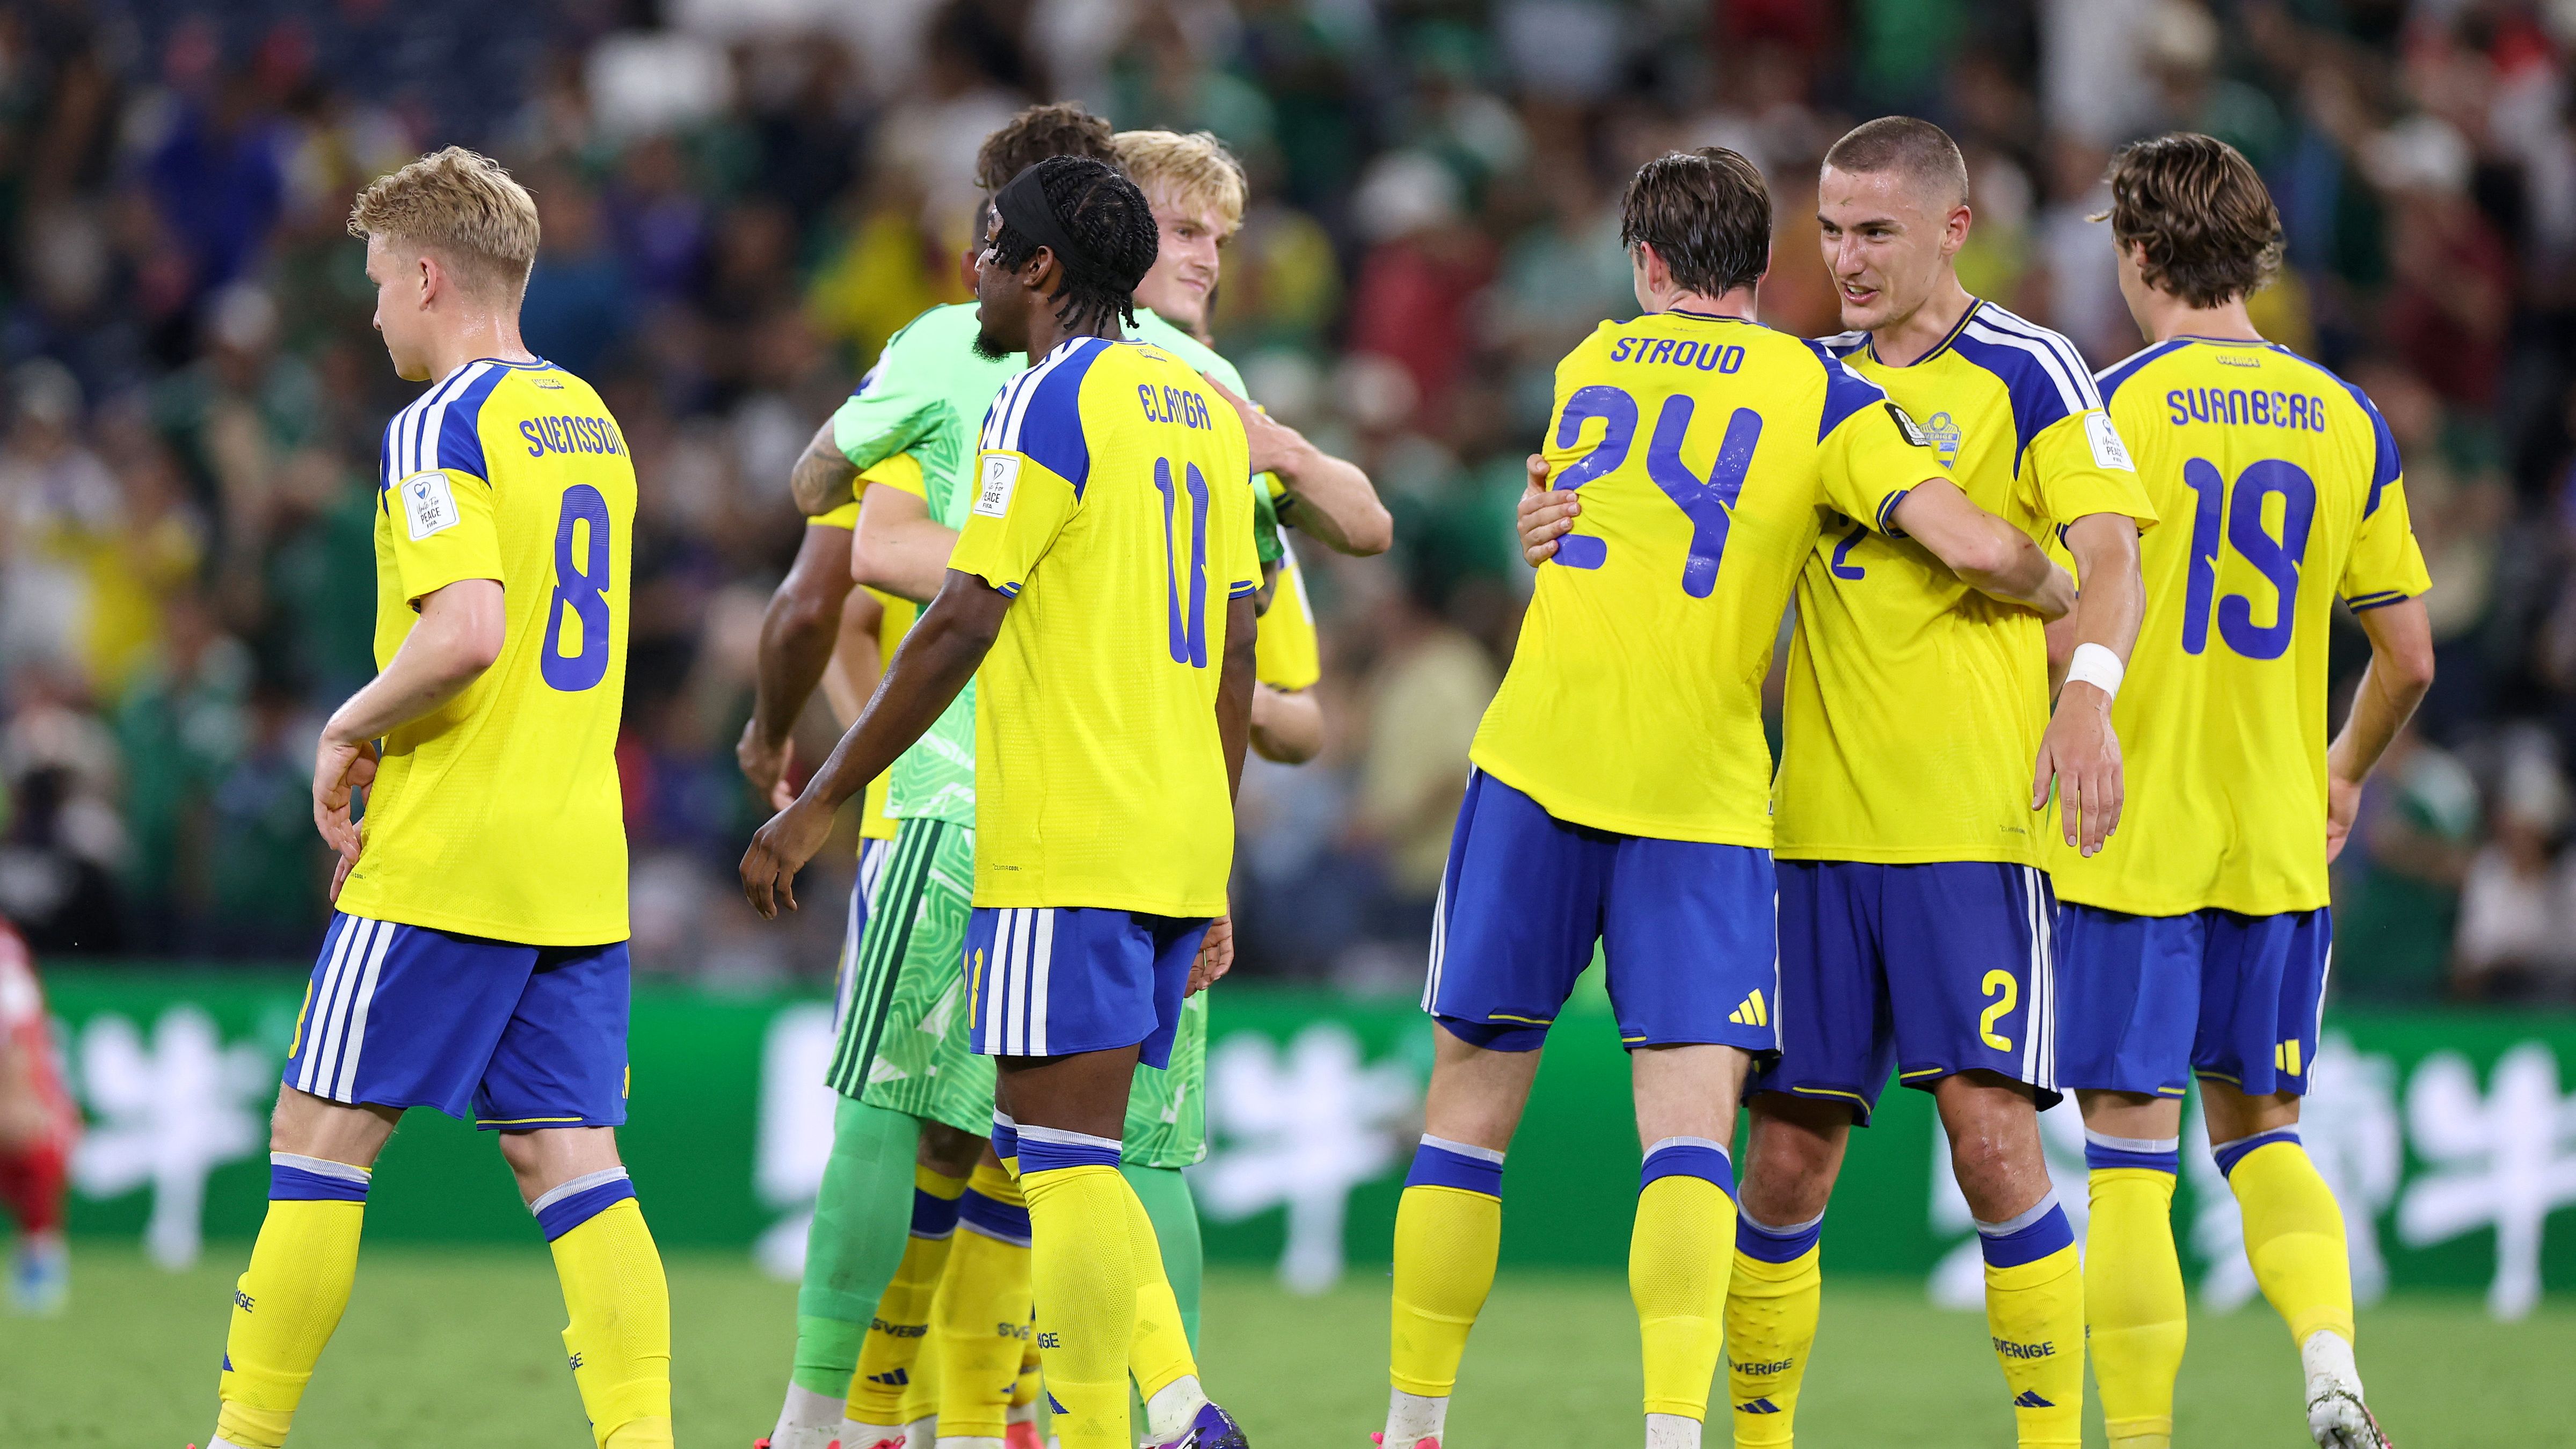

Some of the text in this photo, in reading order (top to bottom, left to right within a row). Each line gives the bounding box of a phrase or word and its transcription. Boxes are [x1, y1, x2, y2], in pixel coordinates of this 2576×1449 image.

[1611, 337, 1745, 374] STROUD
[1138, 384, 1211, 431] ELANGA
[2167, 387, 2324, 433] SVANBERG
[519, 416, 626, 457] SVENSSON
[429, 497, 439, 507] For
[1551, 385, 1764, 599] 24
[420, 507, 441, 525] PEACE
[427, 520, 437, 529] FIFA
[1154, 456, 1209, 668] 11
[2181, 457, 2316, 660] 19
[540, 484, 610, 692] 8
[1980, 969, 2018, 1053] 2
